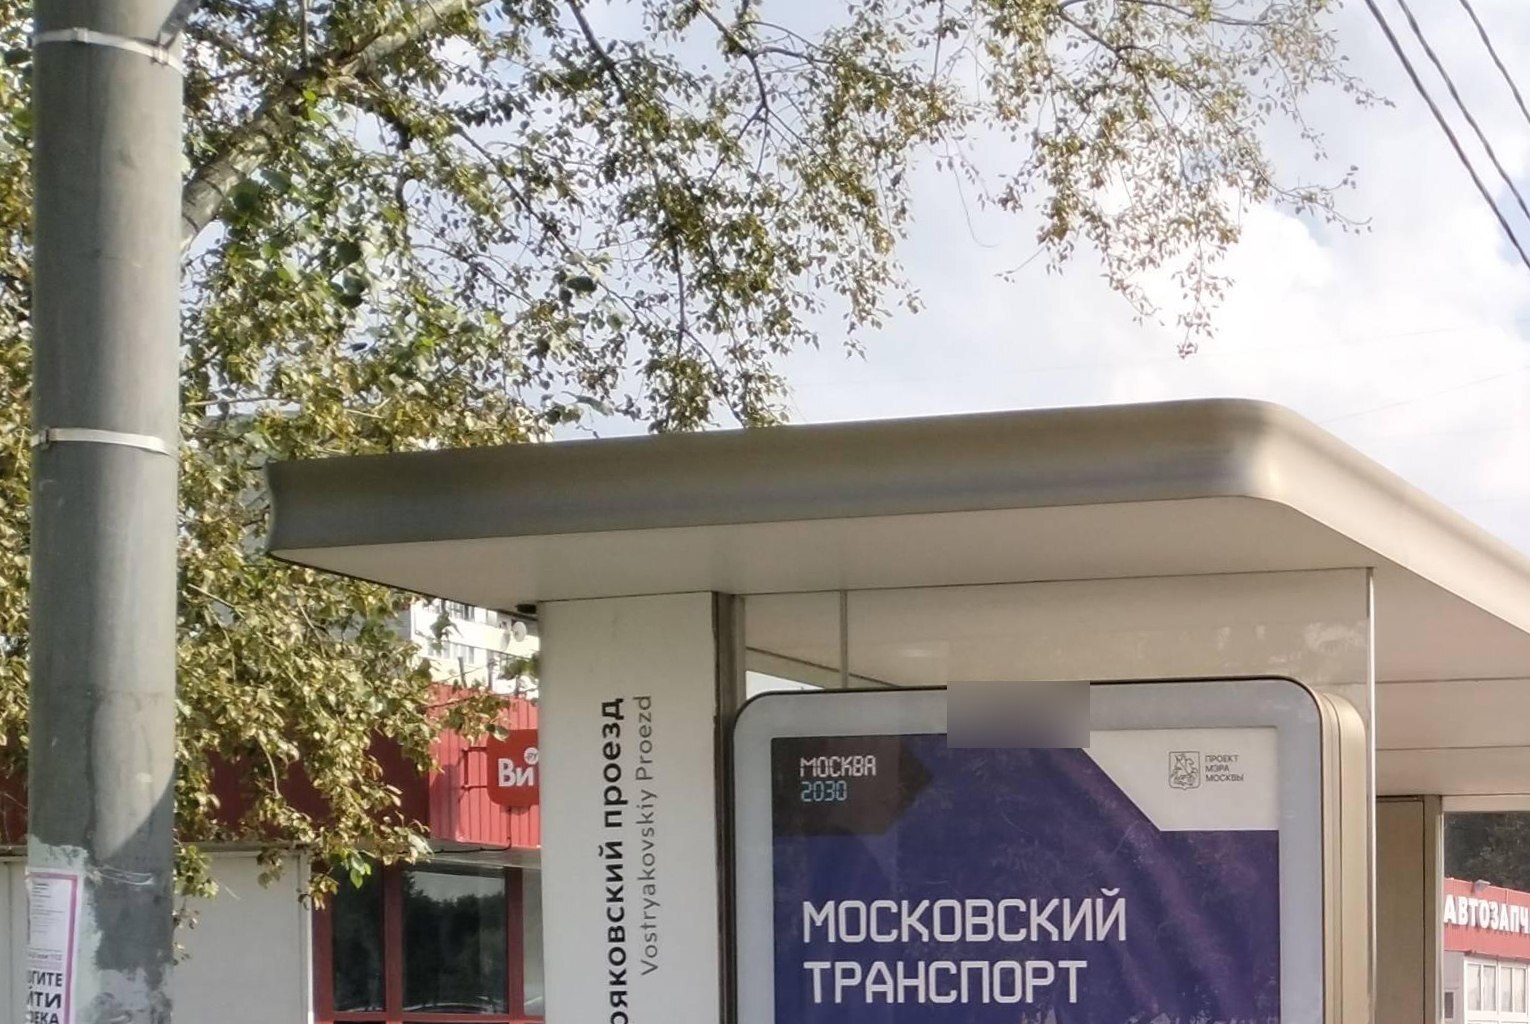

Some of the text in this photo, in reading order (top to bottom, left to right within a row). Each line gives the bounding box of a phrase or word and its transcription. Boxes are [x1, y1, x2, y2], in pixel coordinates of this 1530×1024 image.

[601, 698, 629, 828] проезд
[800, 754, 877, 778] МОСКВА
[1204, 754, 1239, 763] ПРОЕКТ
[1204, 764, 1230, 773] МЭРА
[1204, 773, 1245, 782] МОСКВЫ
[800, 780, 848, 802] 2030
[632, 695, 661, 976] Vostryakovskiy Proezd
[802, 887, 1127, 943] МОСКОВСКИЙ
[802, 960, 1088, 1004] ТРАНСПОРТ
